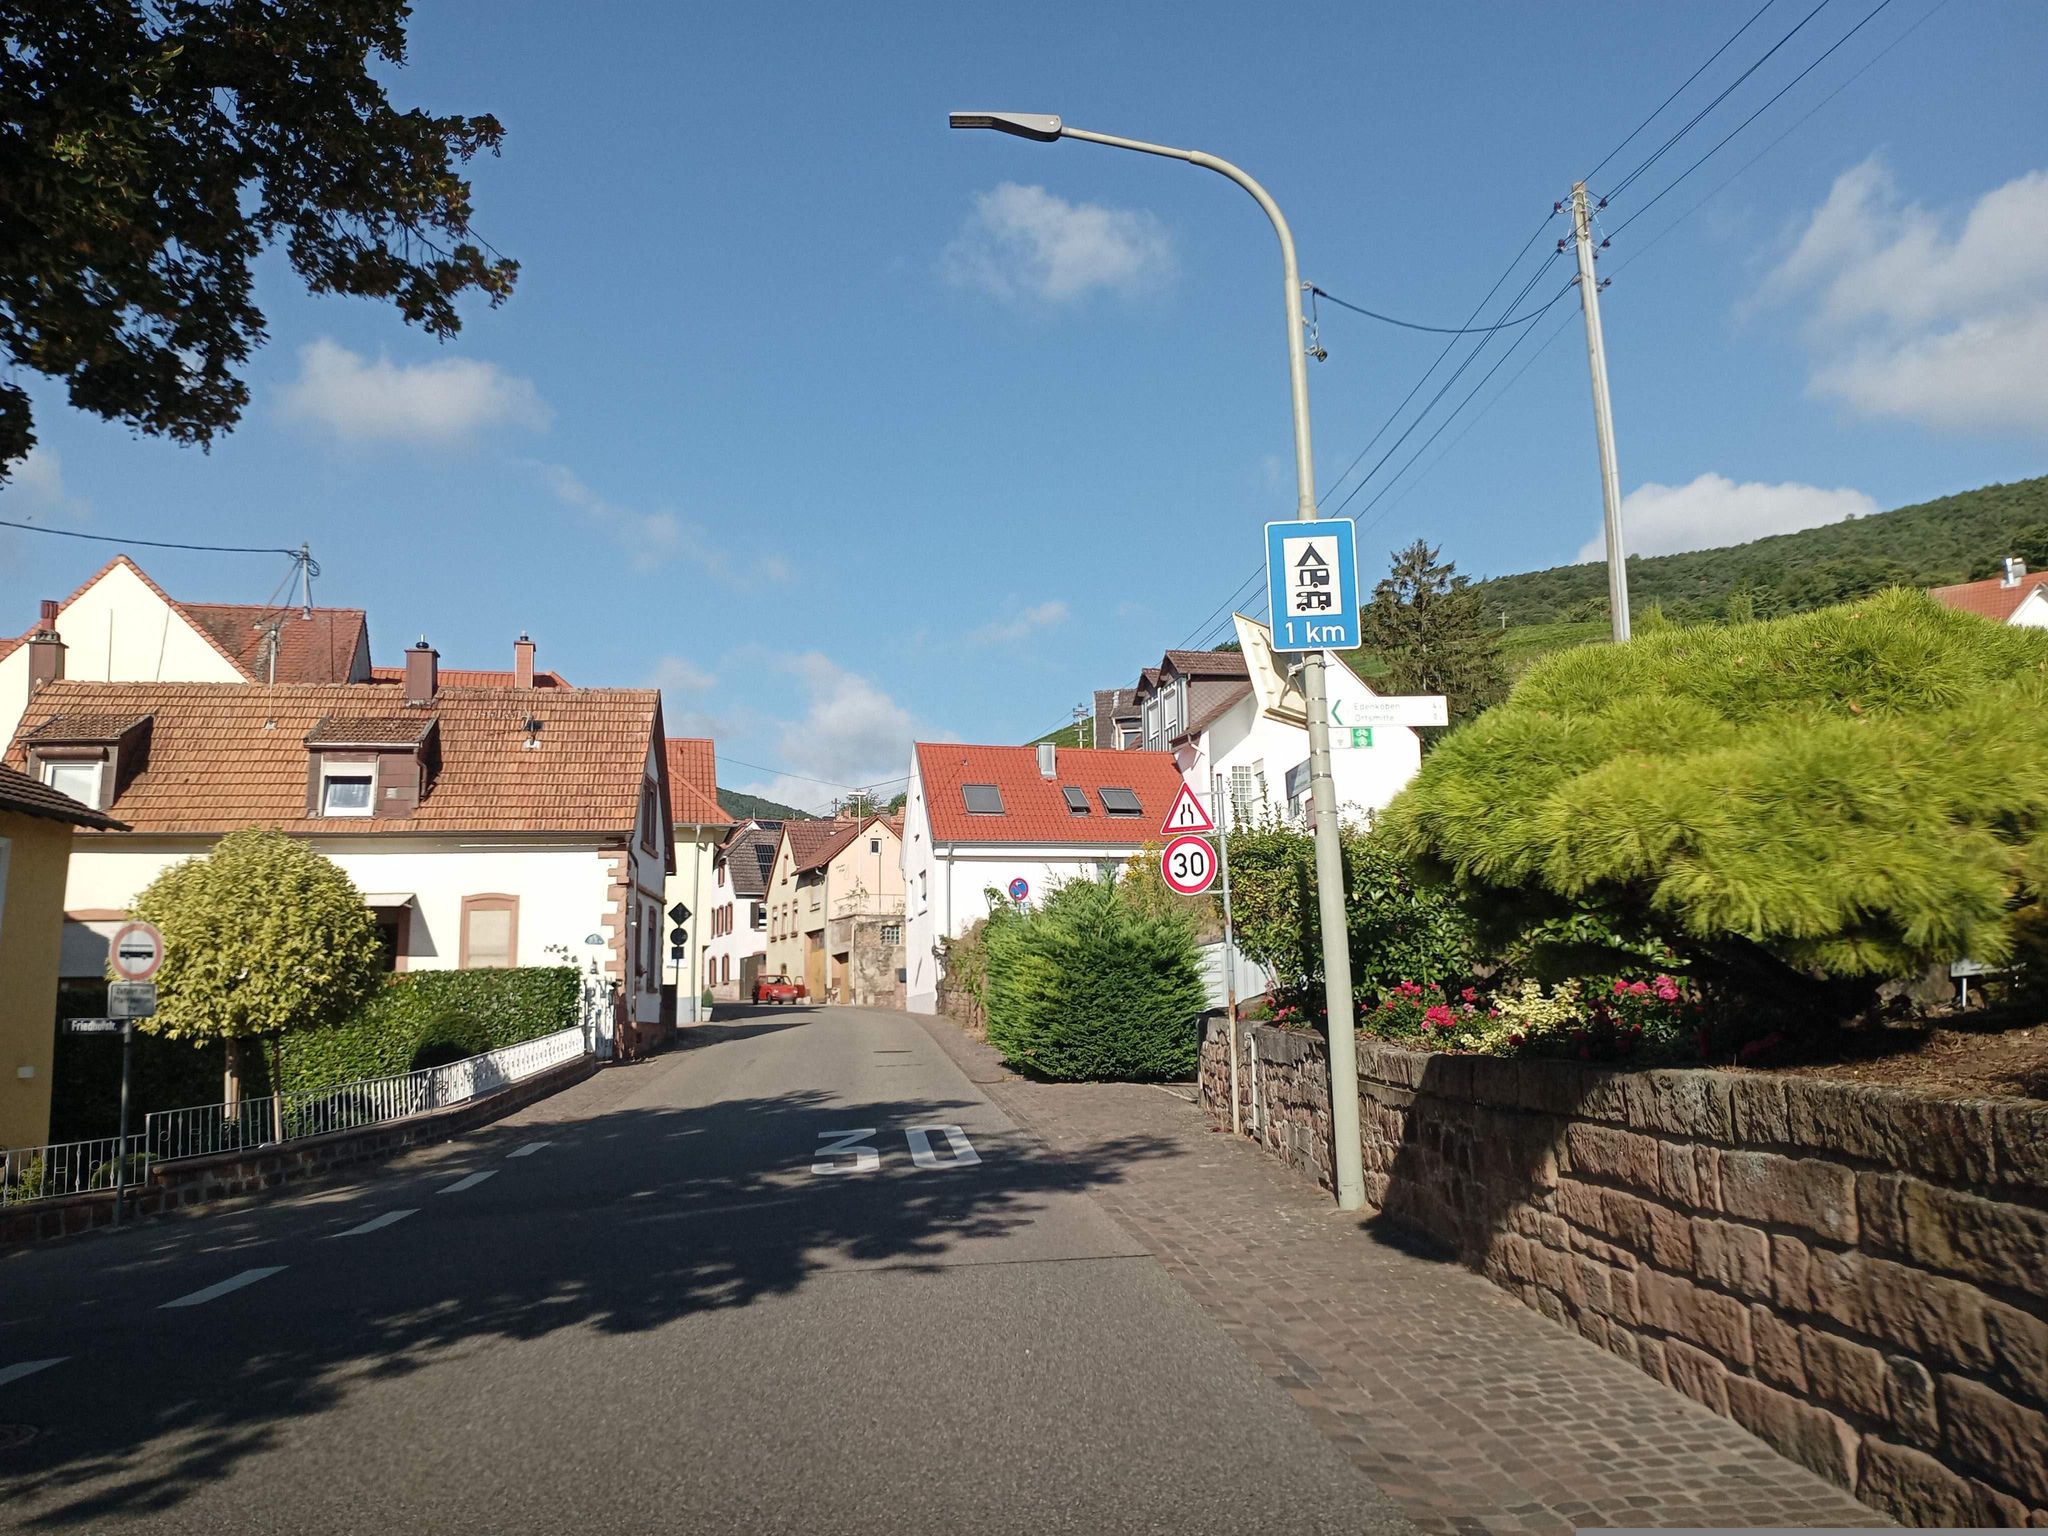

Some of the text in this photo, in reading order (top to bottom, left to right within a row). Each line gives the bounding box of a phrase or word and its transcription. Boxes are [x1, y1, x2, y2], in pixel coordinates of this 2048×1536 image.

[1285, 621, 1345, 644] 1 km
[1174, 851, 1204, 878] 30
[811, 1124, 982, 1175] 30
